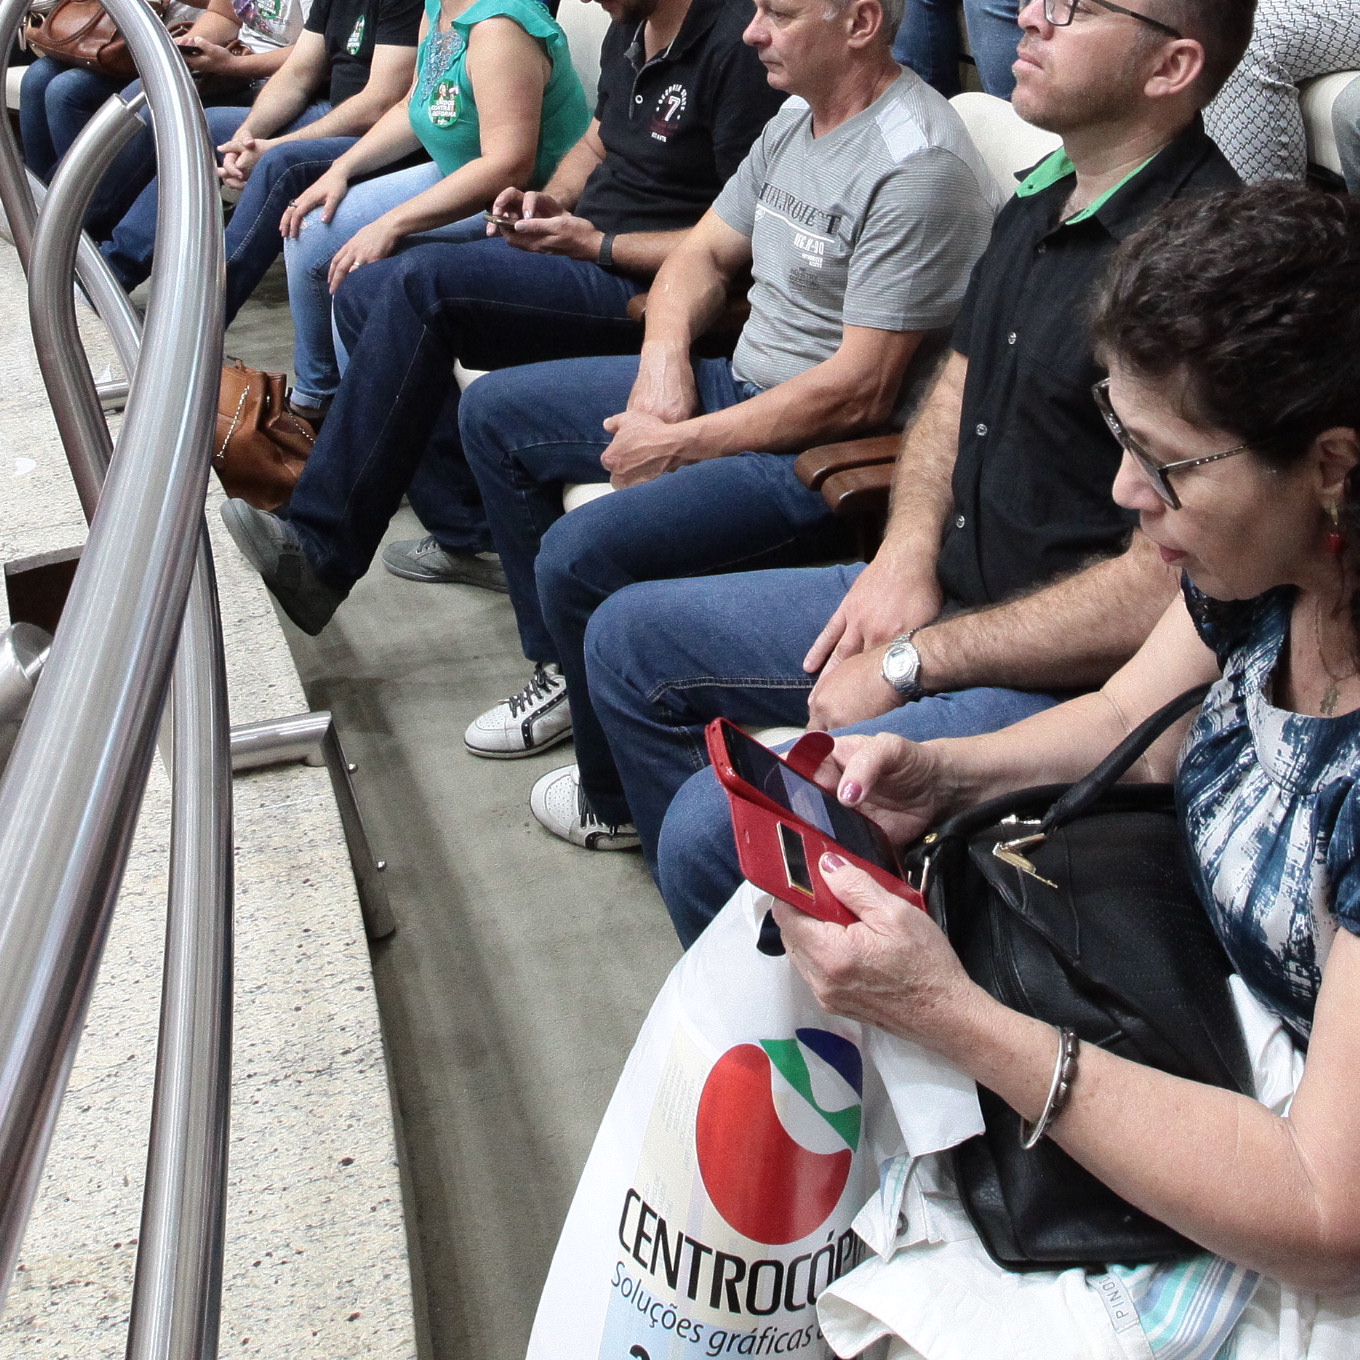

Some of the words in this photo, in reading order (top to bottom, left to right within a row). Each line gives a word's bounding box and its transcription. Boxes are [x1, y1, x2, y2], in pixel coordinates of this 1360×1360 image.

[665, 96, 681, 122] 7
[611, 1260, 704, 1343] Soluções
[706, 1323, 813, 1357] gráficas
